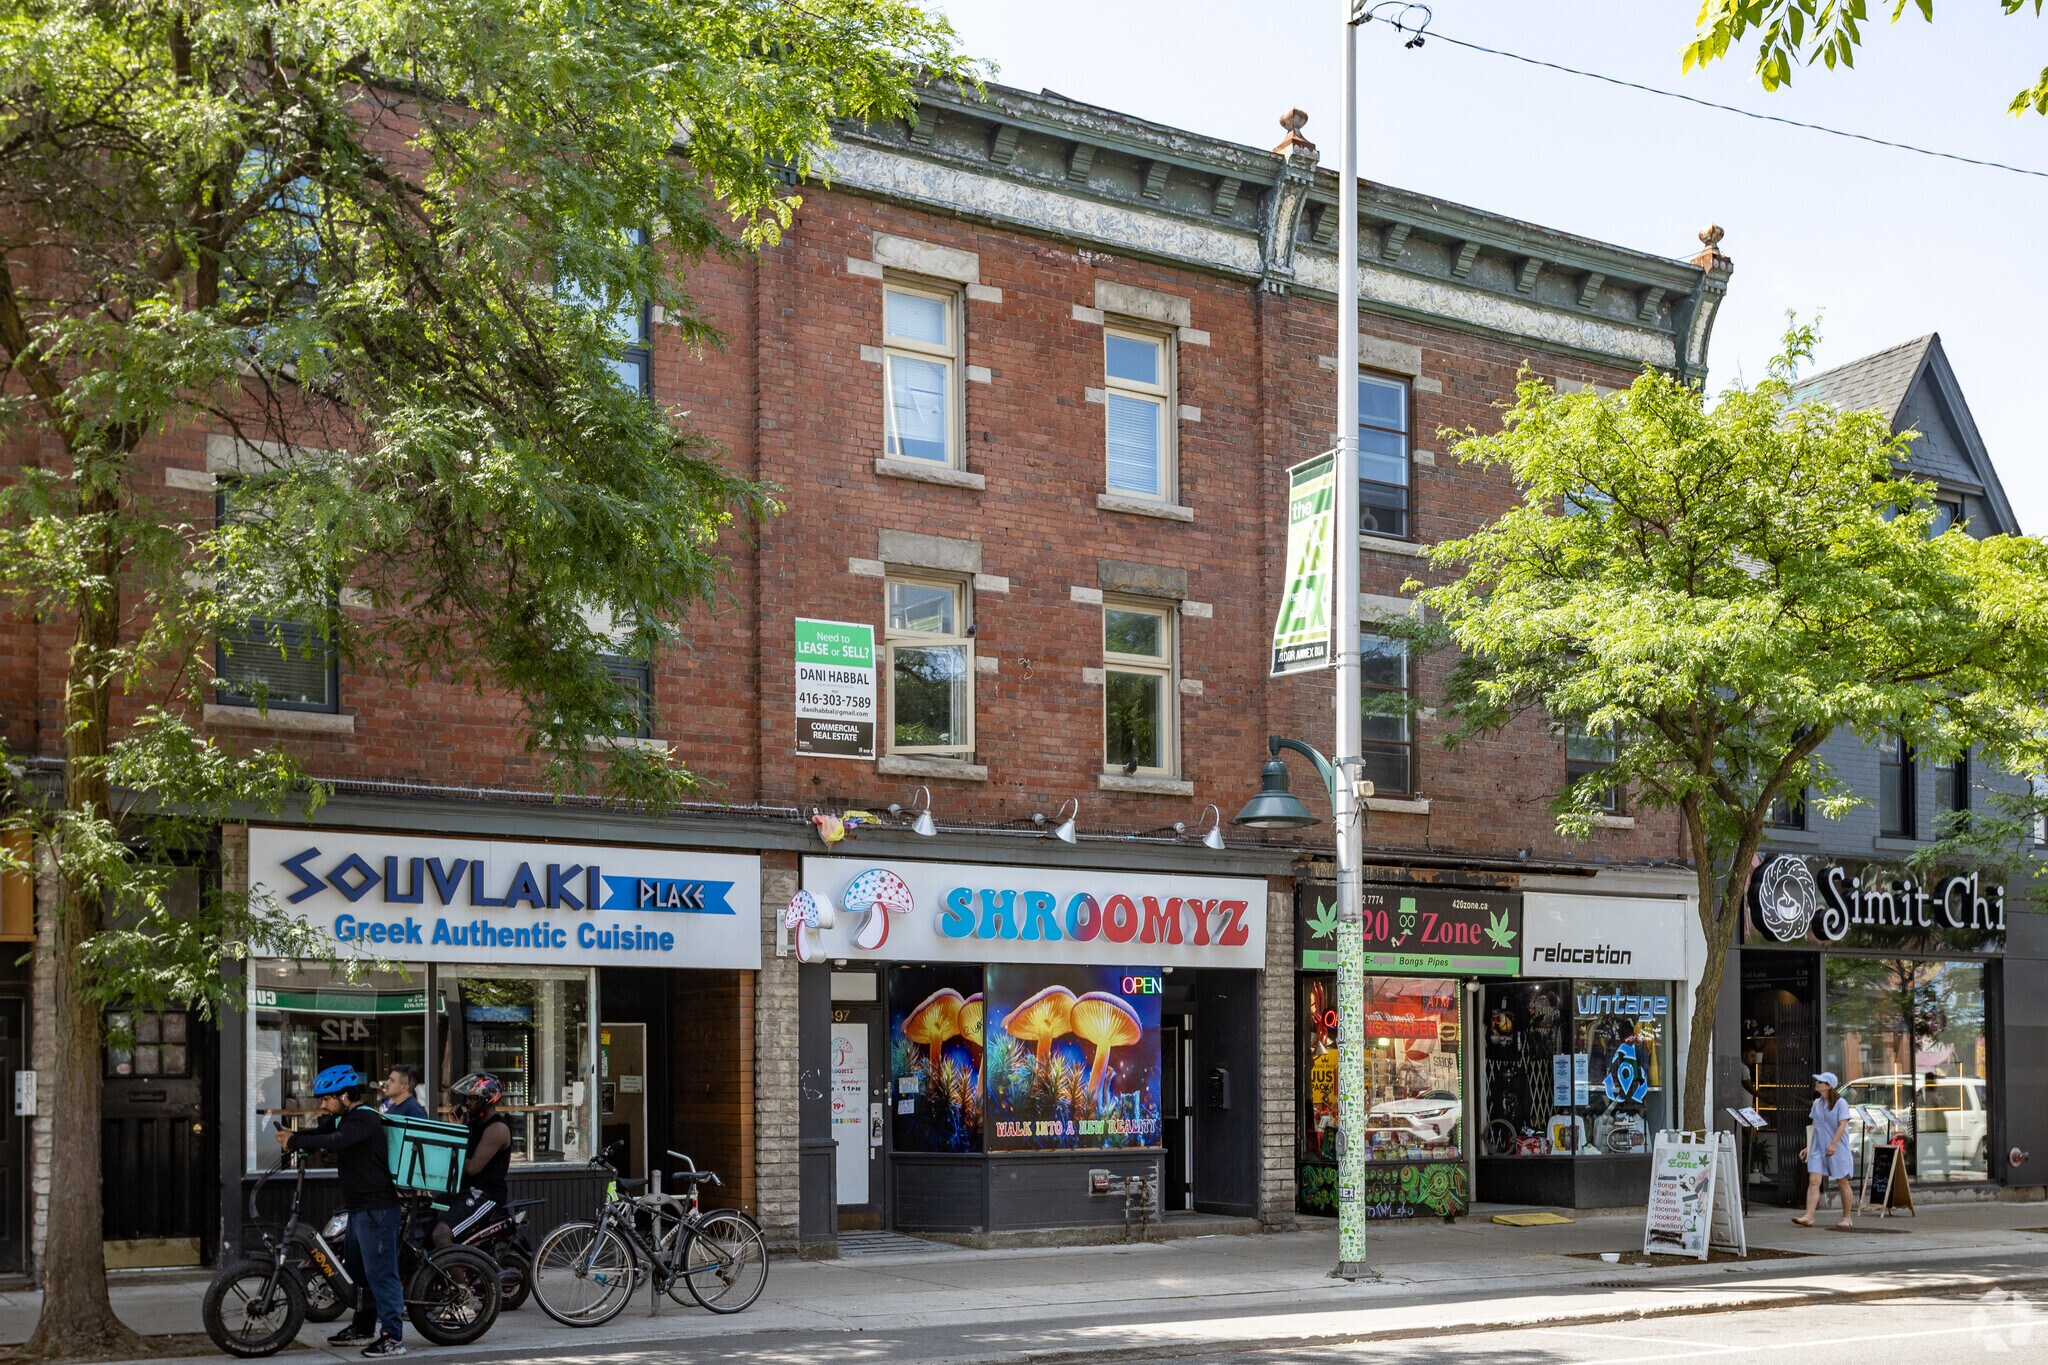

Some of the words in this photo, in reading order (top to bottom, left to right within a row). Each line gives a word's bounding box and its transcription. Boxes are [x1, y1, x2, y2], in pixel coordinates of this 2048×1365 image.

[1292, 501, 1312, 520] the
[816, 631, 839, 643] Need
[840, 634, 850, 643] to
[798, 641, 829, 656] LEASE
[831, 648, 840, 656] or
[842, 645, 870, 659] SELL?
[800, 668, 826, 682] DANI
[828, 671, 870, 685] HABBAL
[799, 692, 871, 709] 416-303-7589
[802, 706, 869, 717] danihabbal@gmail.com
[811, 722, 860, 733] COMMERCIAL
[813, 731, 832, 740] REAL
[832, 732, 858, 742] ESTATE
[280, 846, 601, 912] SOUVLAKI
[636, 877, 706, 910] PLACE
[1367, 895, 1384, 905] 7774
[1452, 899, 1488, 911] 420zone.ca
[1822, 865, 2006, 942] Simit-Chi
[940, 886, 1250, 947] SHROOMYZ
[334, 913, 423, 946] Greek
[431, 916, 567, 951] Authentic
[577, 922, 675, 952] Cuisine
[1362, 909, 1389, 942] 20
[1420, 912, 1482, 945] Zone
[1533, 942, 1631, 966] relocation
[1399, 956, 1424, 968] Bongs
[1427, 957, 1449, 968] Pipes
[1121, 976, 1162, 995] OPEN
[1426, 995, 1451, 1009] ATM
[1577, 986, 1669, 1022] vintage
[833, 1102, 845, 1110] 19+
[995, 1121, 1032, 1138] WALK
[1035, 1120, 1063, 1136] INTO
[1066, 1120, 1074, 1135] A
[1079, 1119, 1105, 1135] NEW
[1108, 1118, 1157, 1134] REALITY
[1676, 1151, 1690, 1160] 420
[1667, 1158, 1698, 1169] Zone
[1657, 1182, 1677, 1190] Bongs
[1656, 1197, 1677, 1205] Scales
[1655, 1205, 1680, 1213] Incense
[1653, 1222, 1684, 1230] Jewellery
